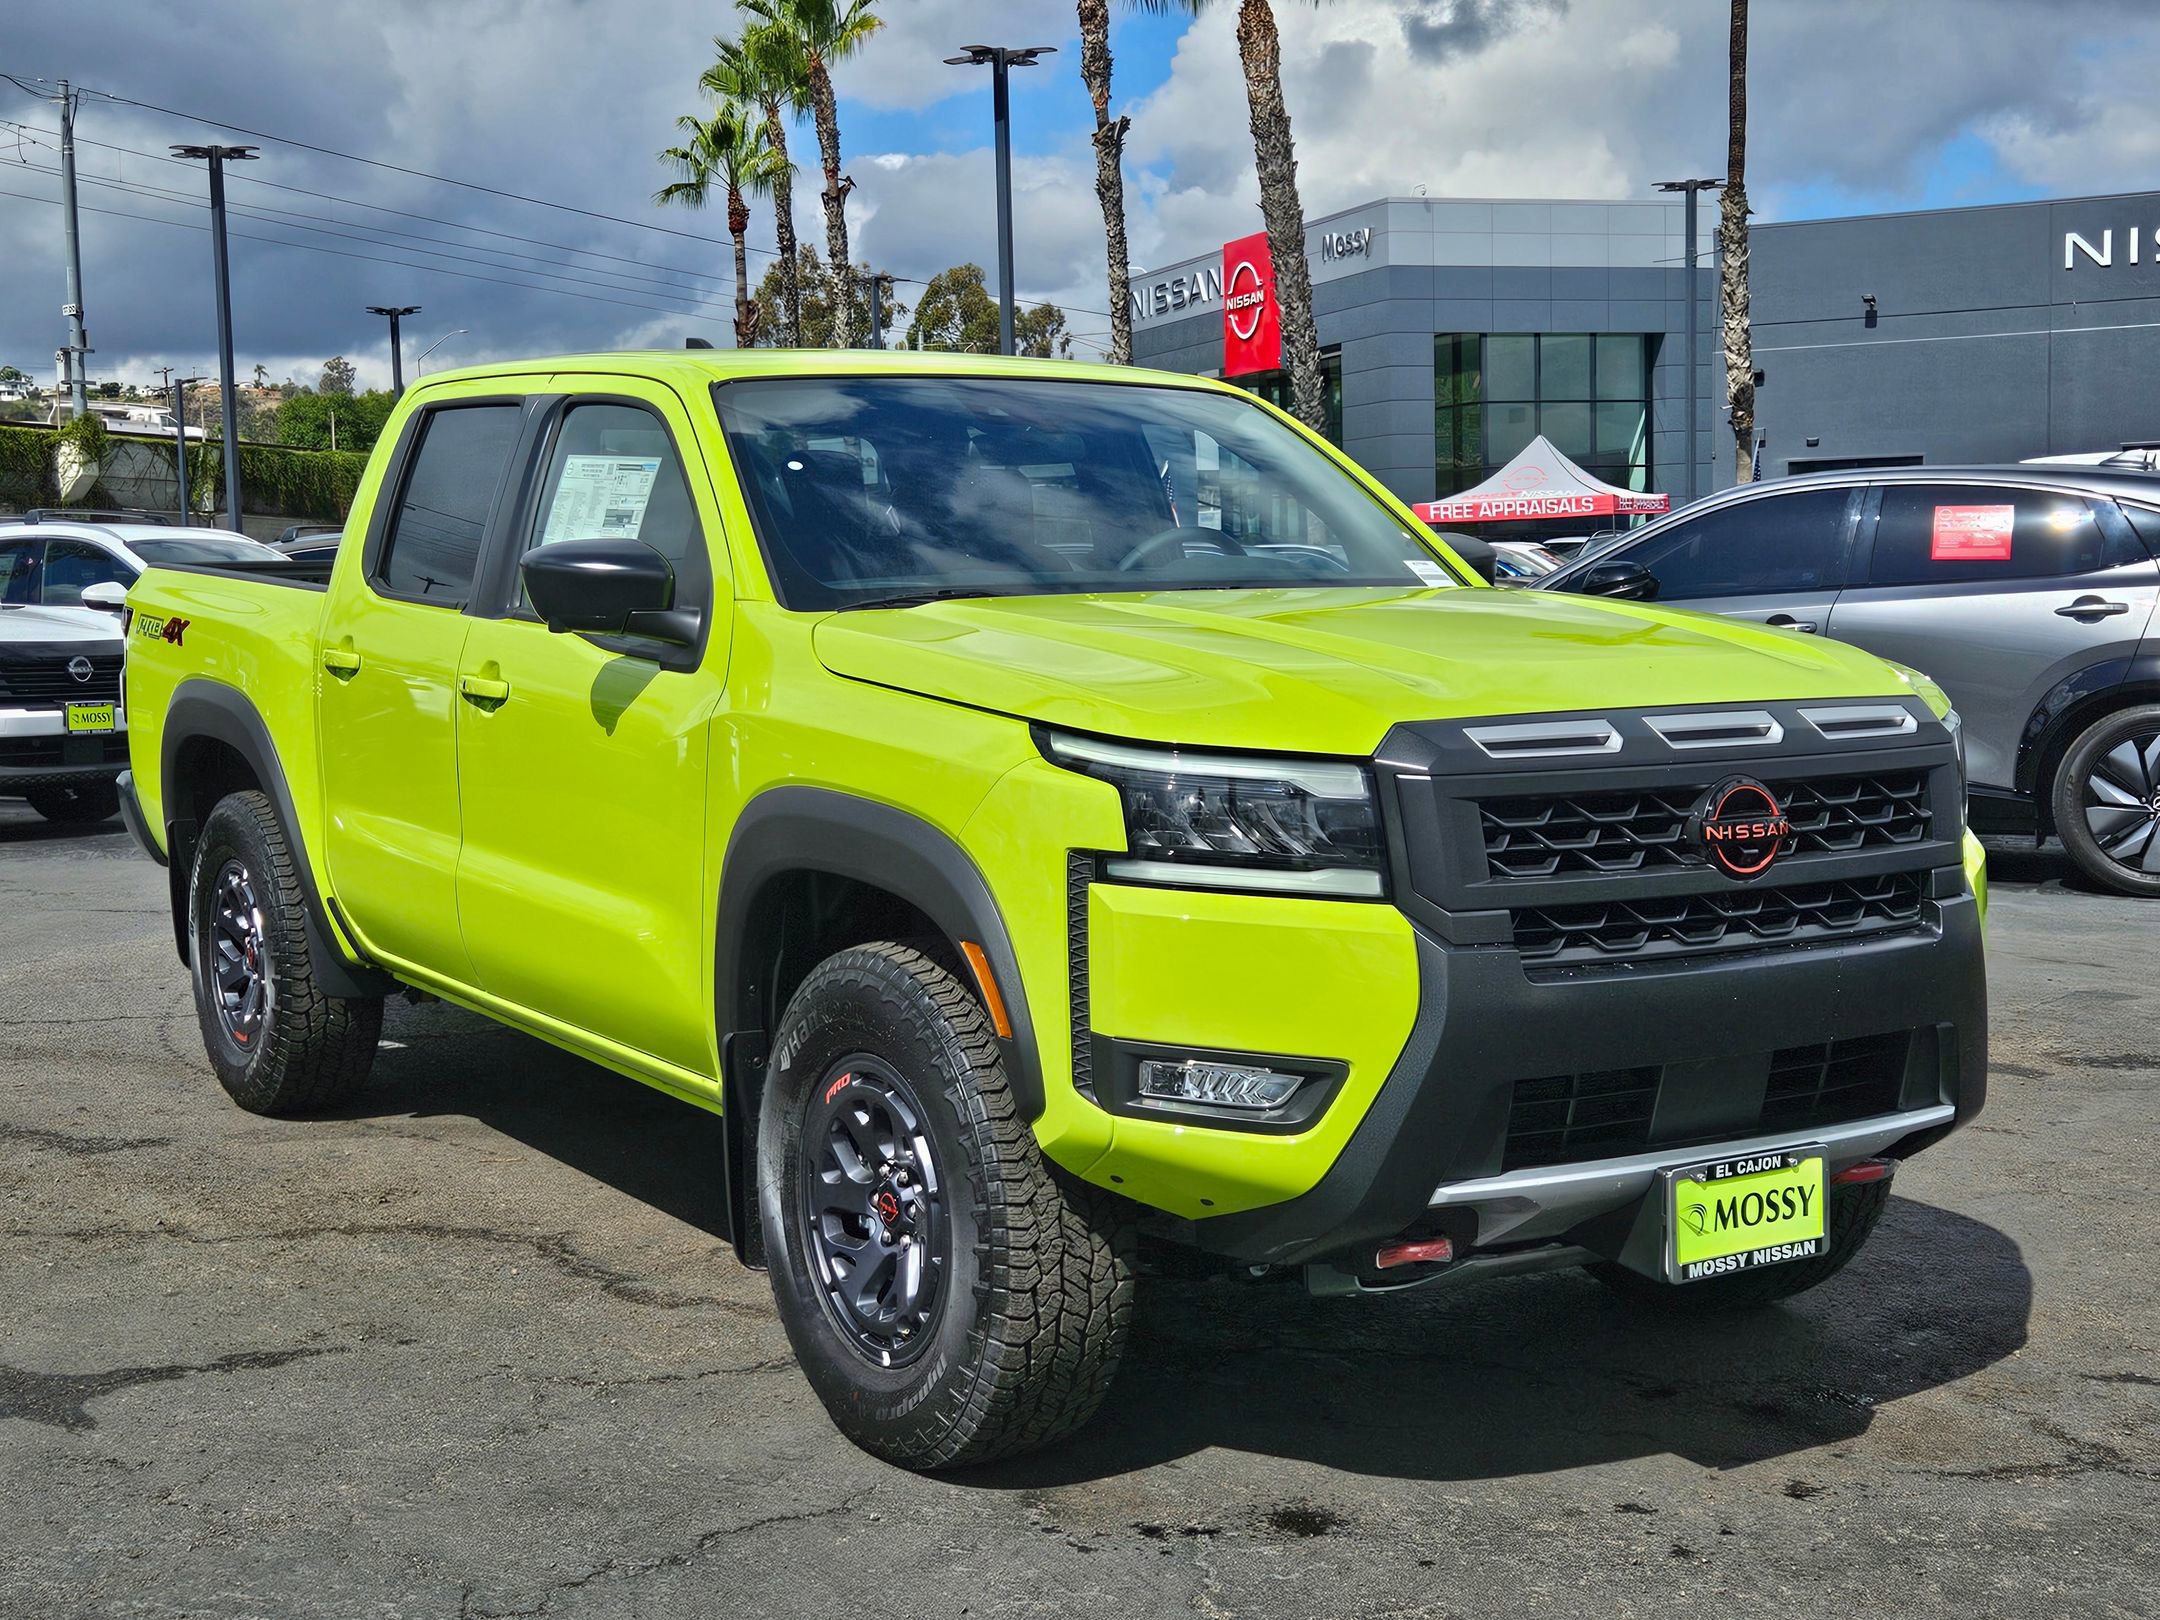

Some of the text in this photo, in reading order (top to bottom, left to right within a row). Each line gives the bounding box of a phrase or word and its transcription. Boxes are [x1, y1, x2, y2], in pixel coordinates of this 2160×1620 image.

[2065, 226, 2160, 271] NI
[1131, 265, 1224, 322] NISSAN
[1226, 289, 1264, 311] NISSAN
[1519, 489, 1577, 498] NISSAN
[1429, 497, 1594, 519] FREE APPRAISALS
[81, 712, 111, 723] MOSSY
[1706, 820, 1789, 840] NISSAN
[825, 1072, 851, 1104] PRO
[1715, 1155, 1782, 1179] EL CAJON
[1713, 1184, 1816, 1233] MOSSY
[1689, 1240, 1816, 1279] MOSSY NISSAN
